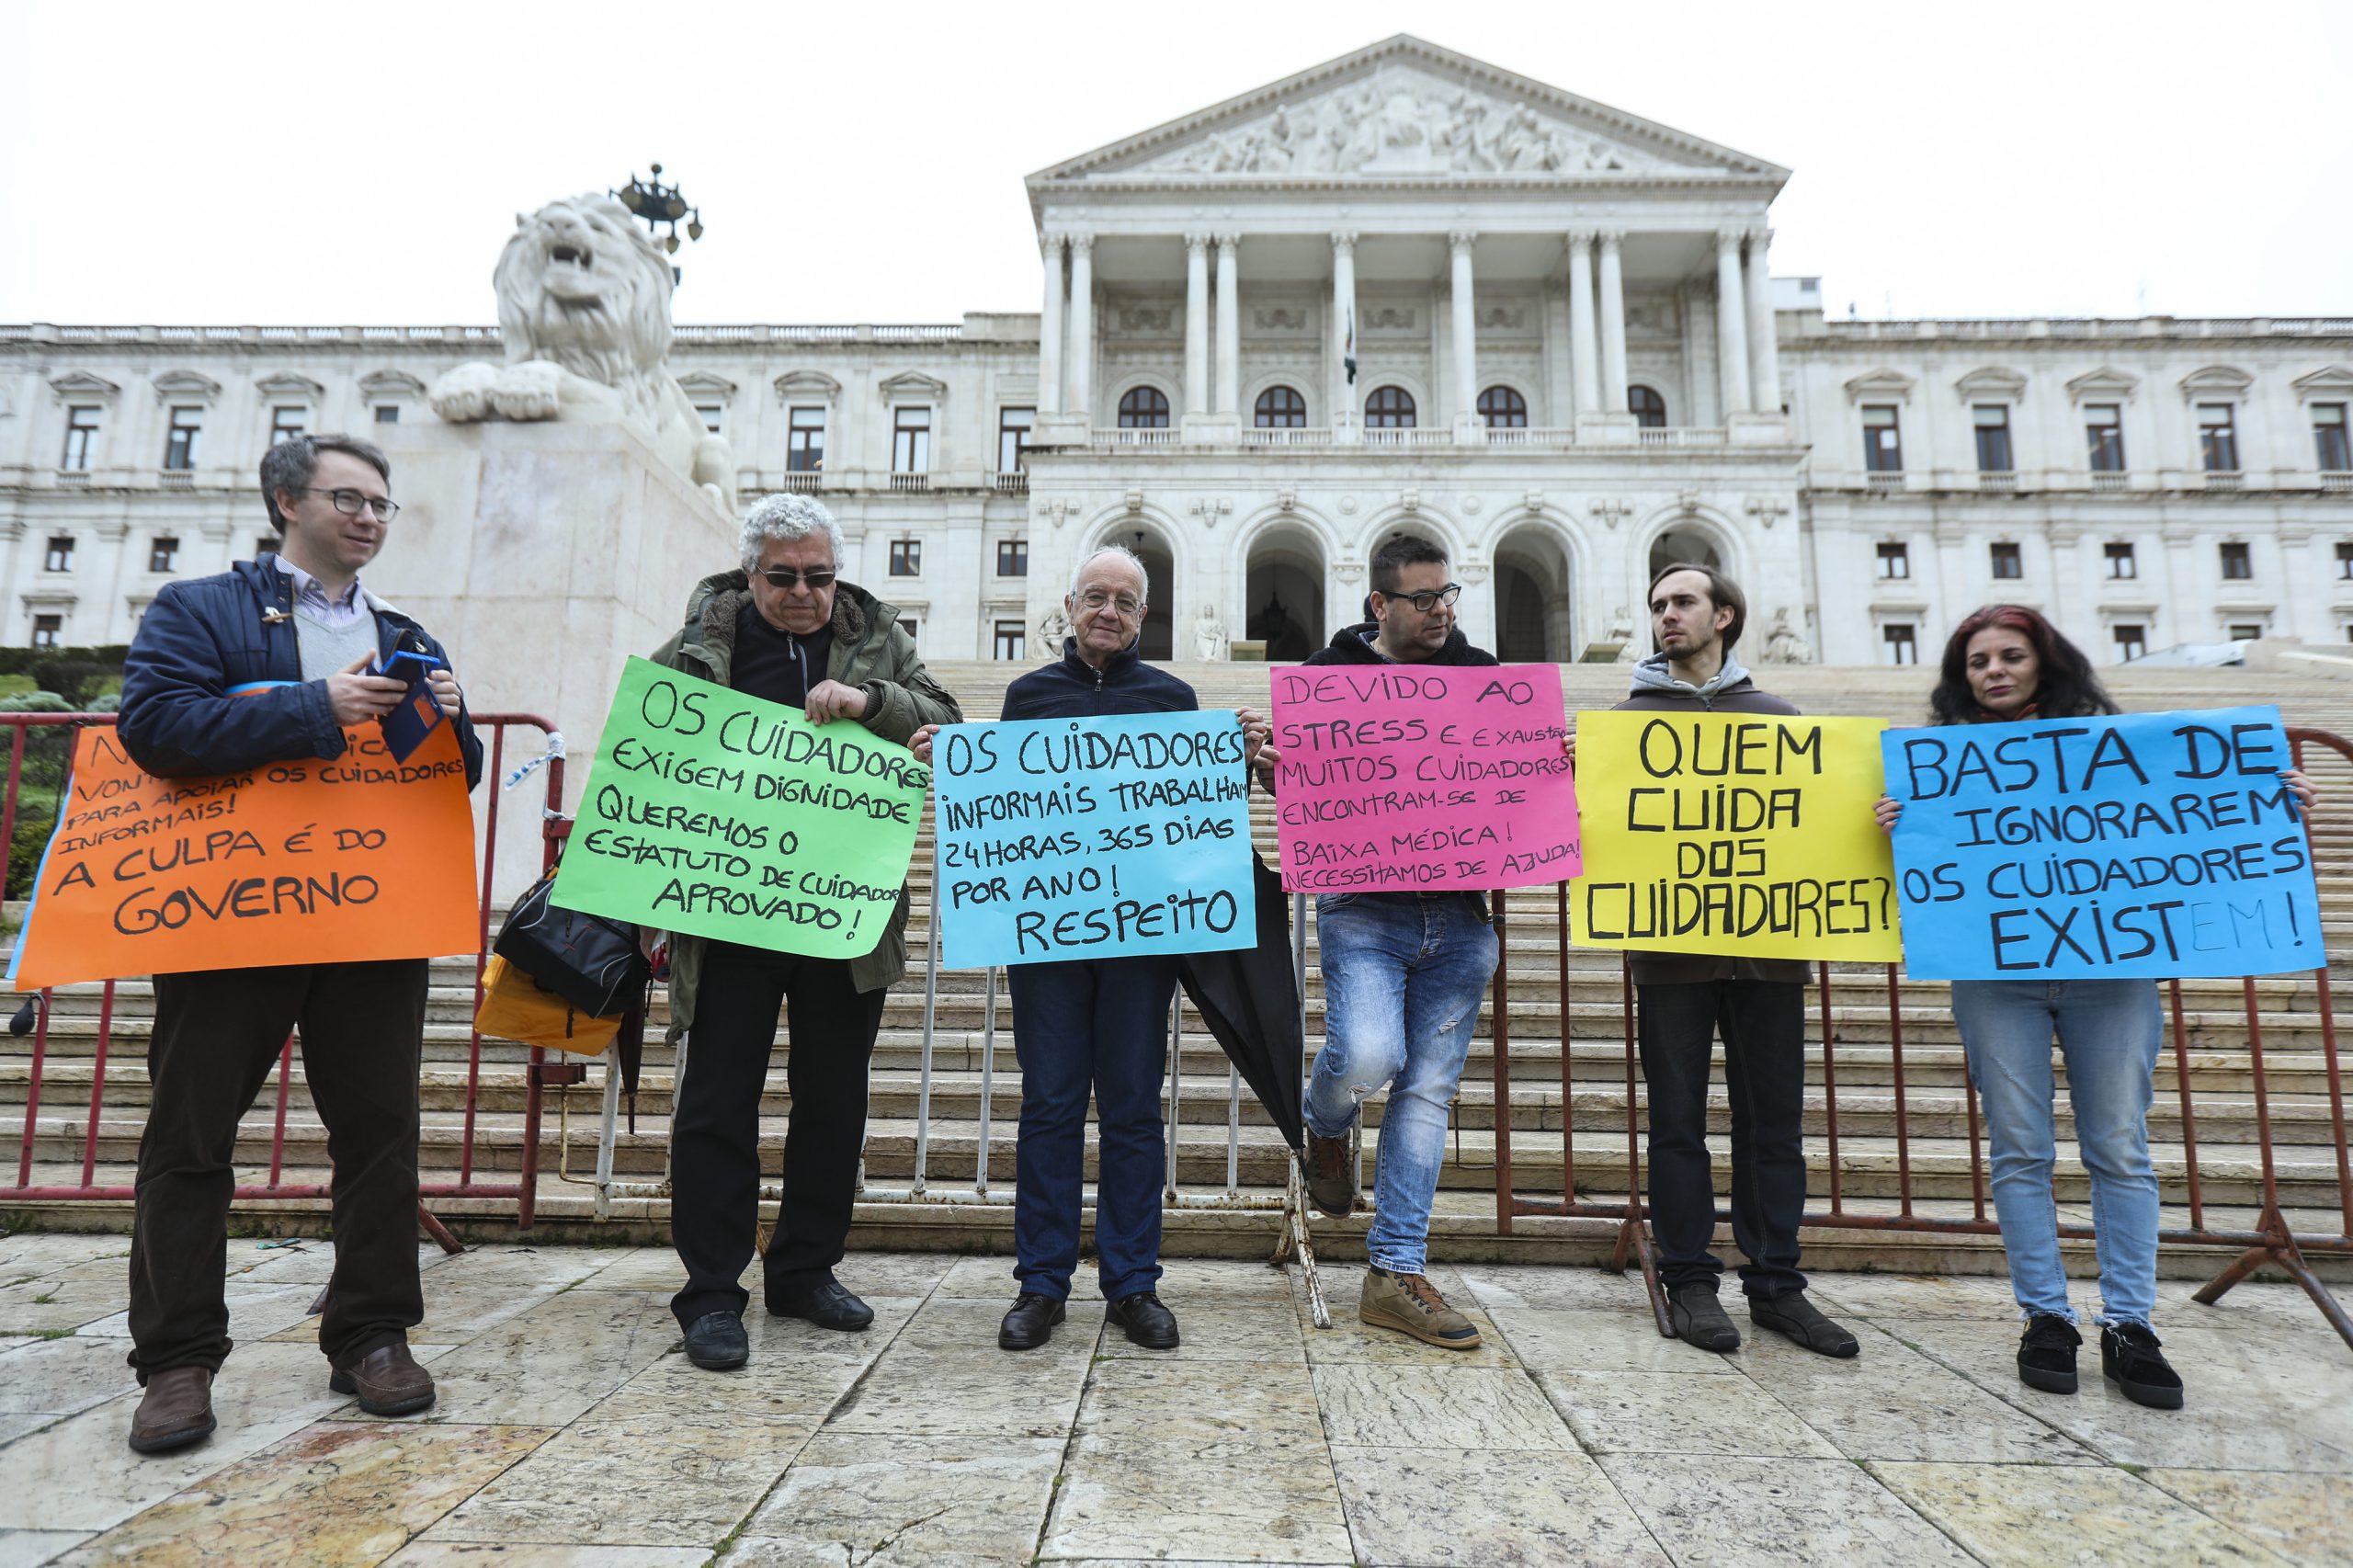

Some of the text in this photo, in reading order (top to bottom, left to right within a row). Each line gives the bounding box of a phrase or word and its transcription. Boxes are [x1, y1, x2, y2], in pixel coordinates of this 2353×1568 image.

[1281, 673, 1533, 705] DEVIDO AO
[642, 681, 928, 789] OS CUIDADORES
[947, 722, 1244, 777] OS CUIDADORES
[1282, 719, 1428, 750] STRESS
[1440, 725, 1461, 744] E
[1639, 719, 1822, 778] QUEM
[1904, 722, 2279, 801] BASTA DE
[67, 801, 141, 830] PARA
[267, 767, 307, 783] OS
[319, 759, 463, 783] CUIDADORES
[612, 737, 744, 793] EXIGEM
[754, 773, 911, 824] DIGNIDADE
[1282, 754, 1569, 788] MUITOS CUIDADORES
[58, 794, 236, 855] INFORMAIS!
[597, 784, 798, 855] QUEREMOS O
[942, 776, 1249, 832] INFORMAIS TRABALHAM
[1097, 824, 1154, 851] 365
[1165, 816, 1234, 845] DIAS
[1282, 790, 1526, 825] ENCONTRAM-SE DE
[1628, 784, 1801, 832] CUIDA
[1954, 787, 2301, 847] IGNORAREM
[53, 824, 387, 896] A CULPA É DO
[585, 829, 899, 903] ESTATUTO DE CUIDADOR
[1286, 839, 1580, 891] NECESSITAMOS DE AJUDA!
[1293, 840, 1379, 866] BAIXA
[1677, 838, 1766, 879] DOS
[1903, 835, 2304, 904] OS CUIDADORES
[113, 872, 380, 936] GOVERNO
[951, 877, 1010, 909] POR
[1016, 889, 1238, 955] RESPEITO
[1586, 877, 1891, 939] CUIDADORES?
[1990, 891, 2303, 971] EXISTEM!
